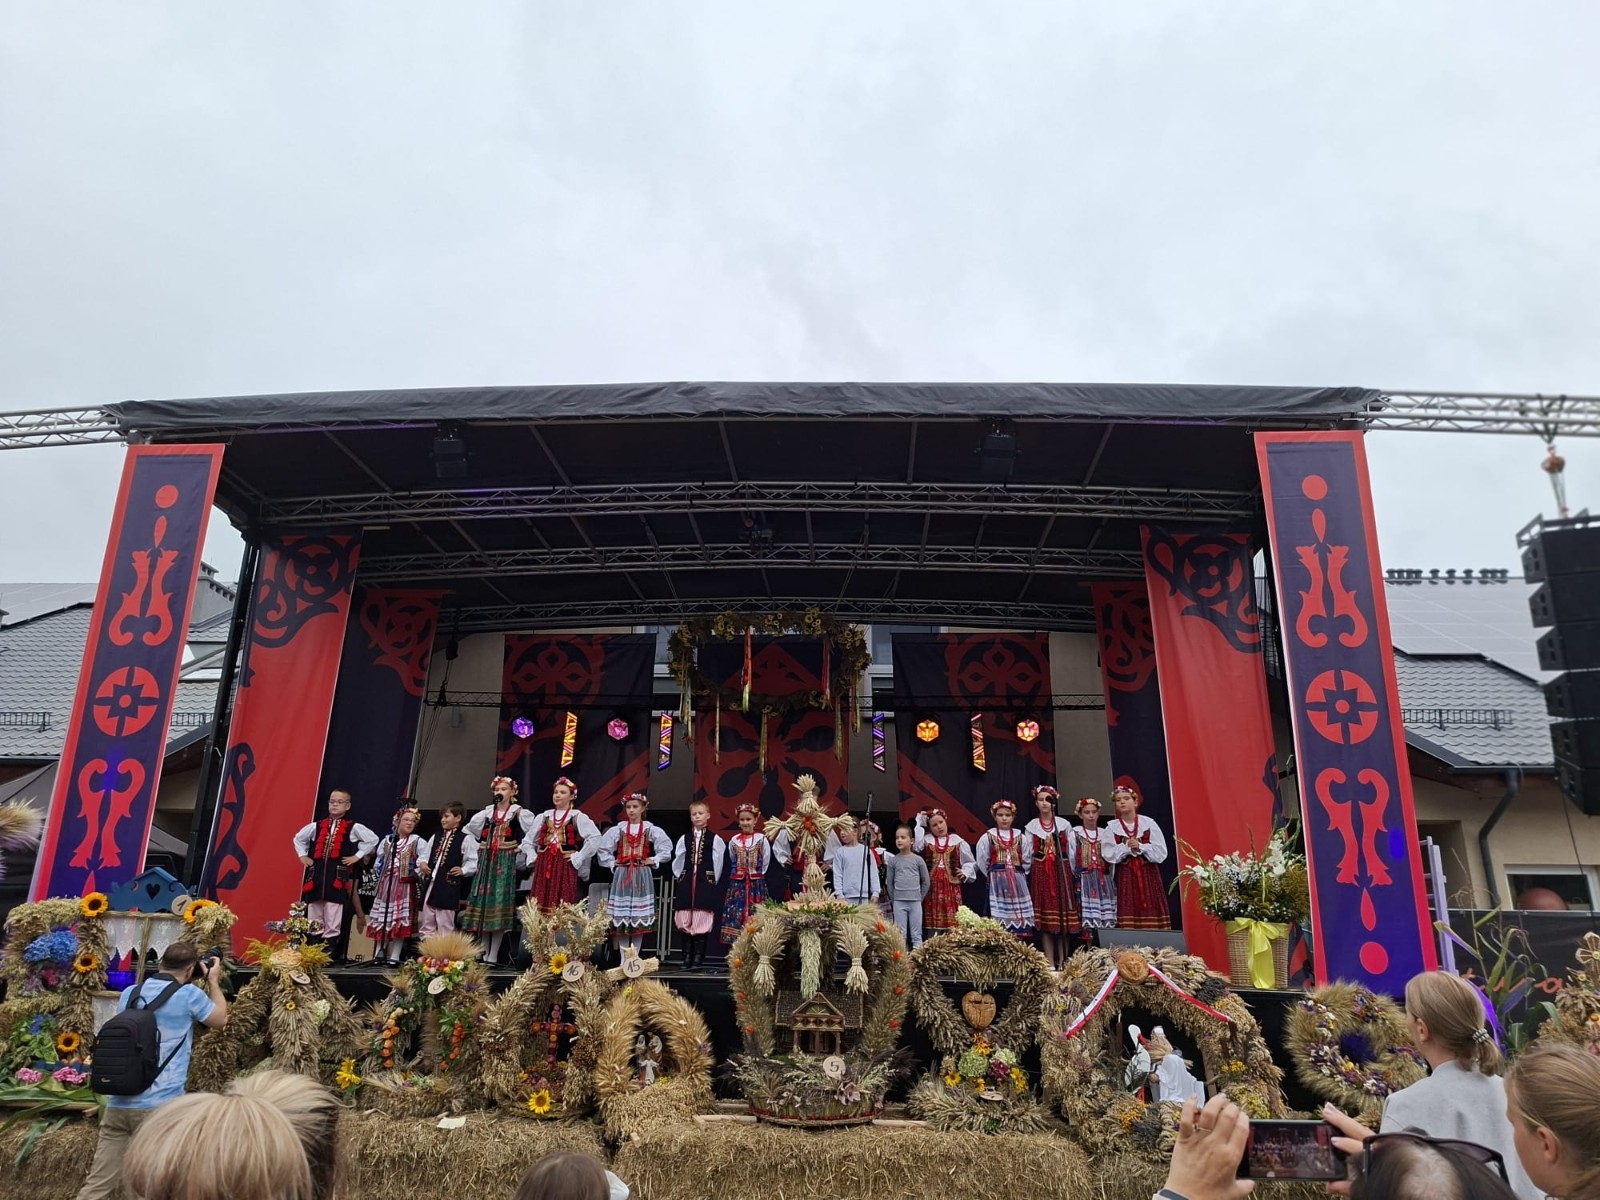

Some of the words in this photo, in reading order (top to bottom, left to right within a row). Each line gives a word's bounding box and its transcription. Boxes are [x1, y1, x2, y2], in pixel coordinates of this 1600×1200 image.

[176, 900, 187, 911] 1
[567, 964, 581, 977] 16
[627, 958, 641, 973] 15
[830, 1060, 840, 1072] 5
